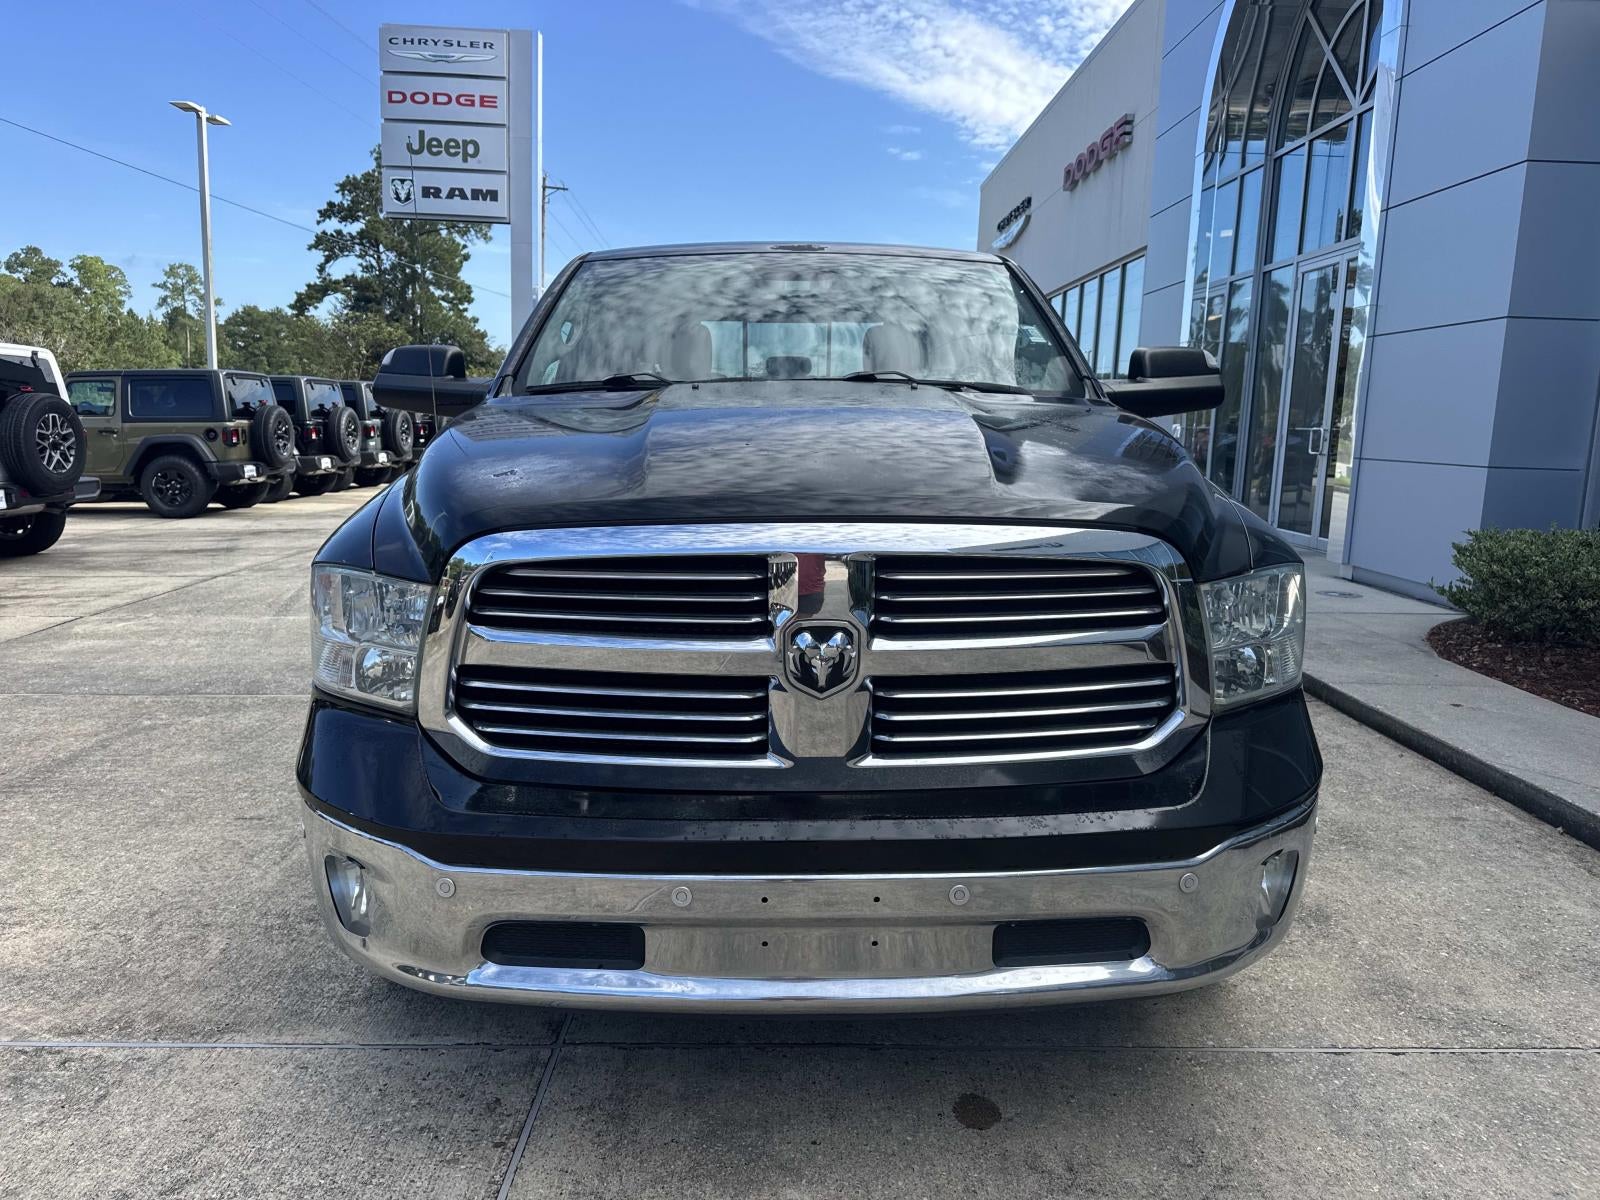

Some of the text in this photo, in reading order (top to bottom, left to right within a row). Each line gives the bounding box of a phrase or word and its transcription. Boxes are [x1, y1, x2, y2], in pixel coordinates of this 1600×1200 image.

[388, 37, 495, 49] CHRYSLER
[388, 90, 498, 109] DODGE
[406, 129, 480, 163] Jeep
[1062, 113, 1135, 192] DODGE
[421, 186, 499, 202] RAM
